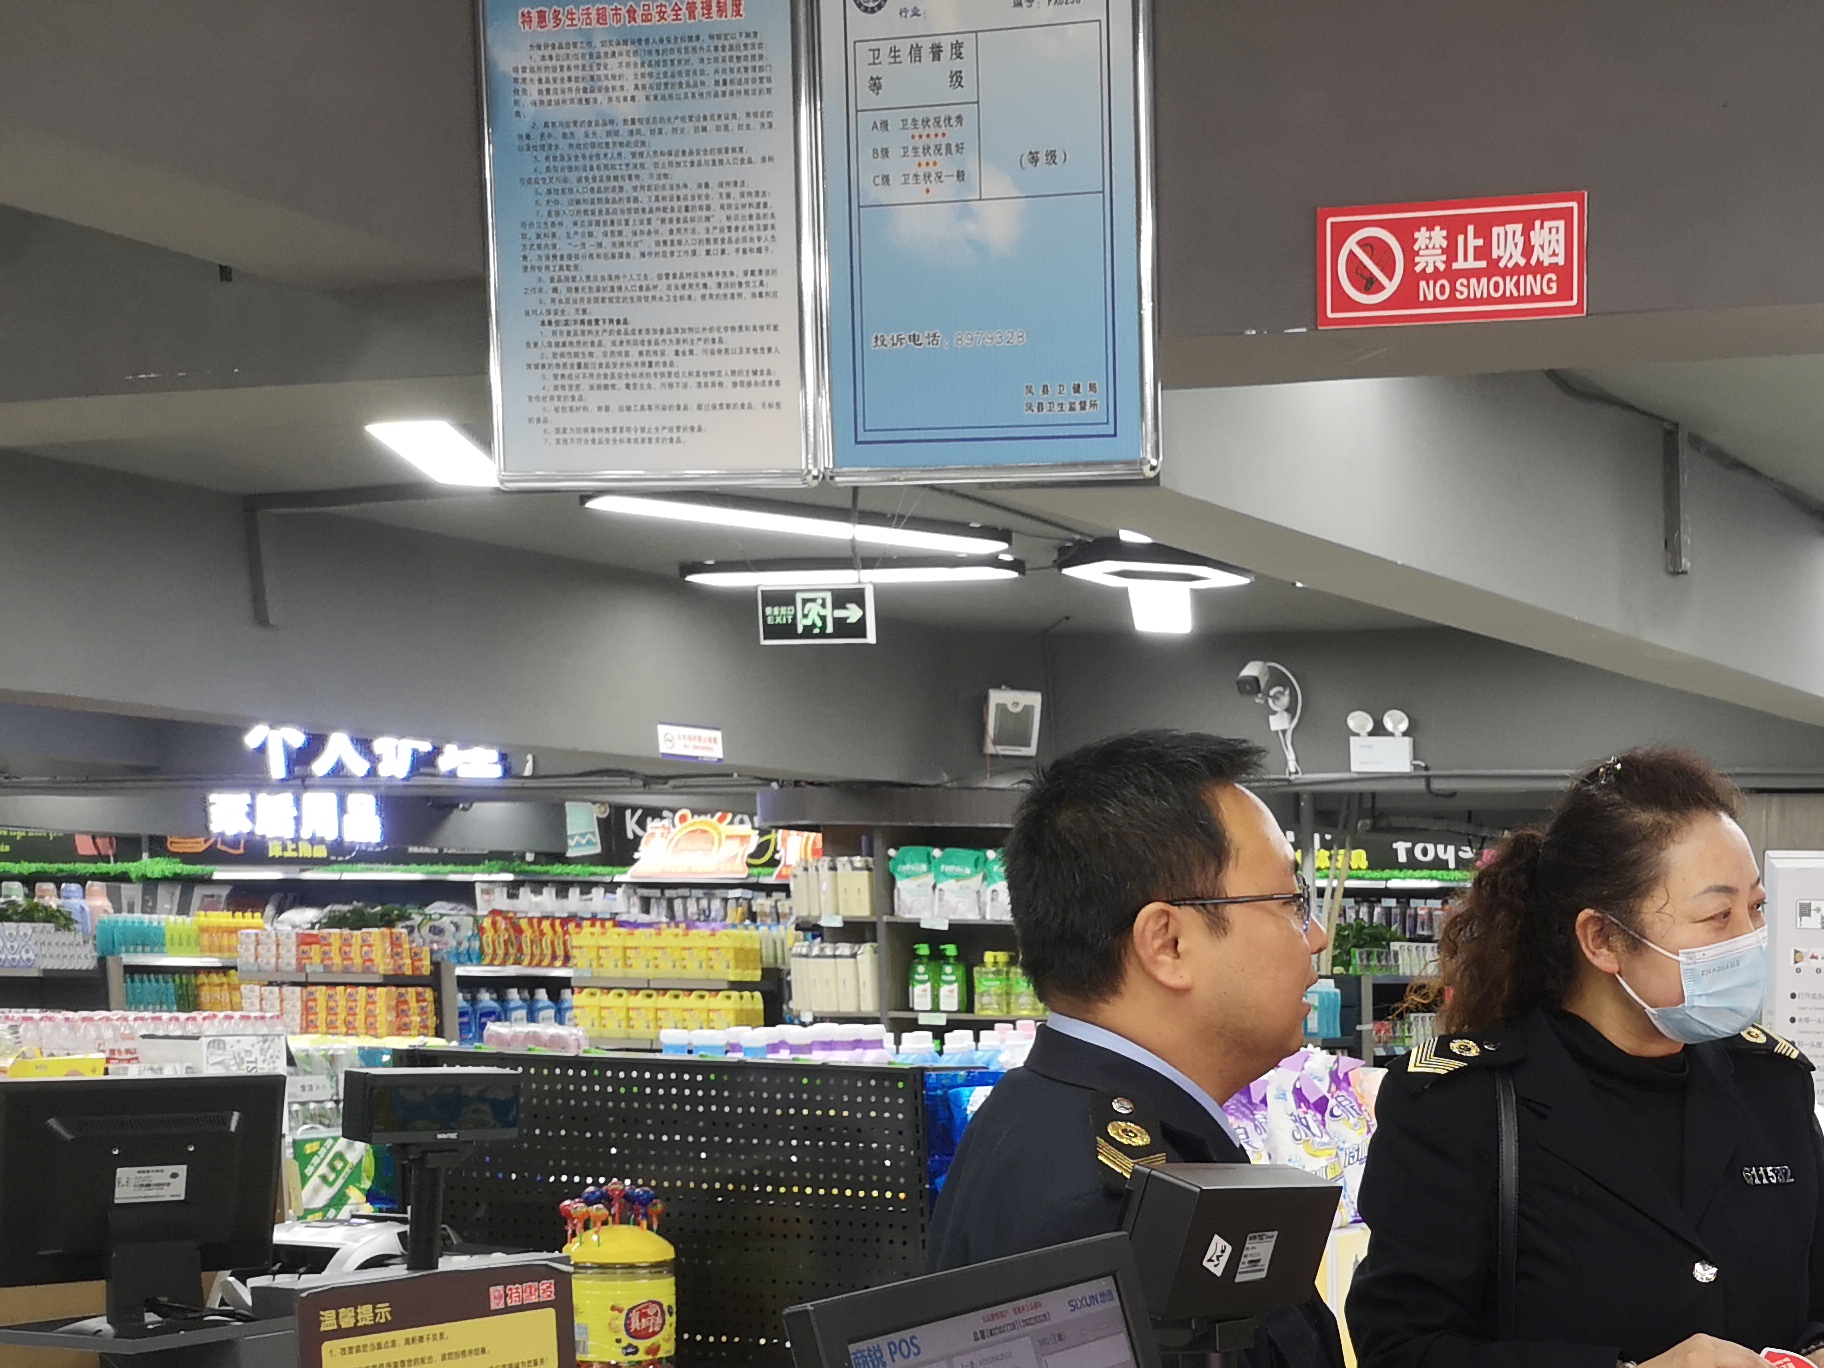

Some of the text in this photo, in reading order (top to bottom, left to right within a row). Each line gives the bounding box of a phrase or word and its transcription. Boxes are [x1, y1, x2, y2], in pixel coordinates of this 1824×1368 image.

[519, 0, 745, 30] 特惠多生活超市食品安全管理制度
[867, 41, 965, 67] 卫生信誉度
[871, 114, 964, 133] A级 卫生状况优秀
[872, 142, 965, 160] B级 卫生状况良好
[873, 170, 966, 187] C级 卫生状况一般
[1413, 220, 1567, 275] 禁止吸烟
[1419, 273, 1558, 302] NO SMOKING
[767, 615, 793, 625] EXIT
[506, 1279, 556, 1305] 特惠多
[319, 1302, 393, 1332] 温馨提示
[887, 1335, 922, 1363] POS
